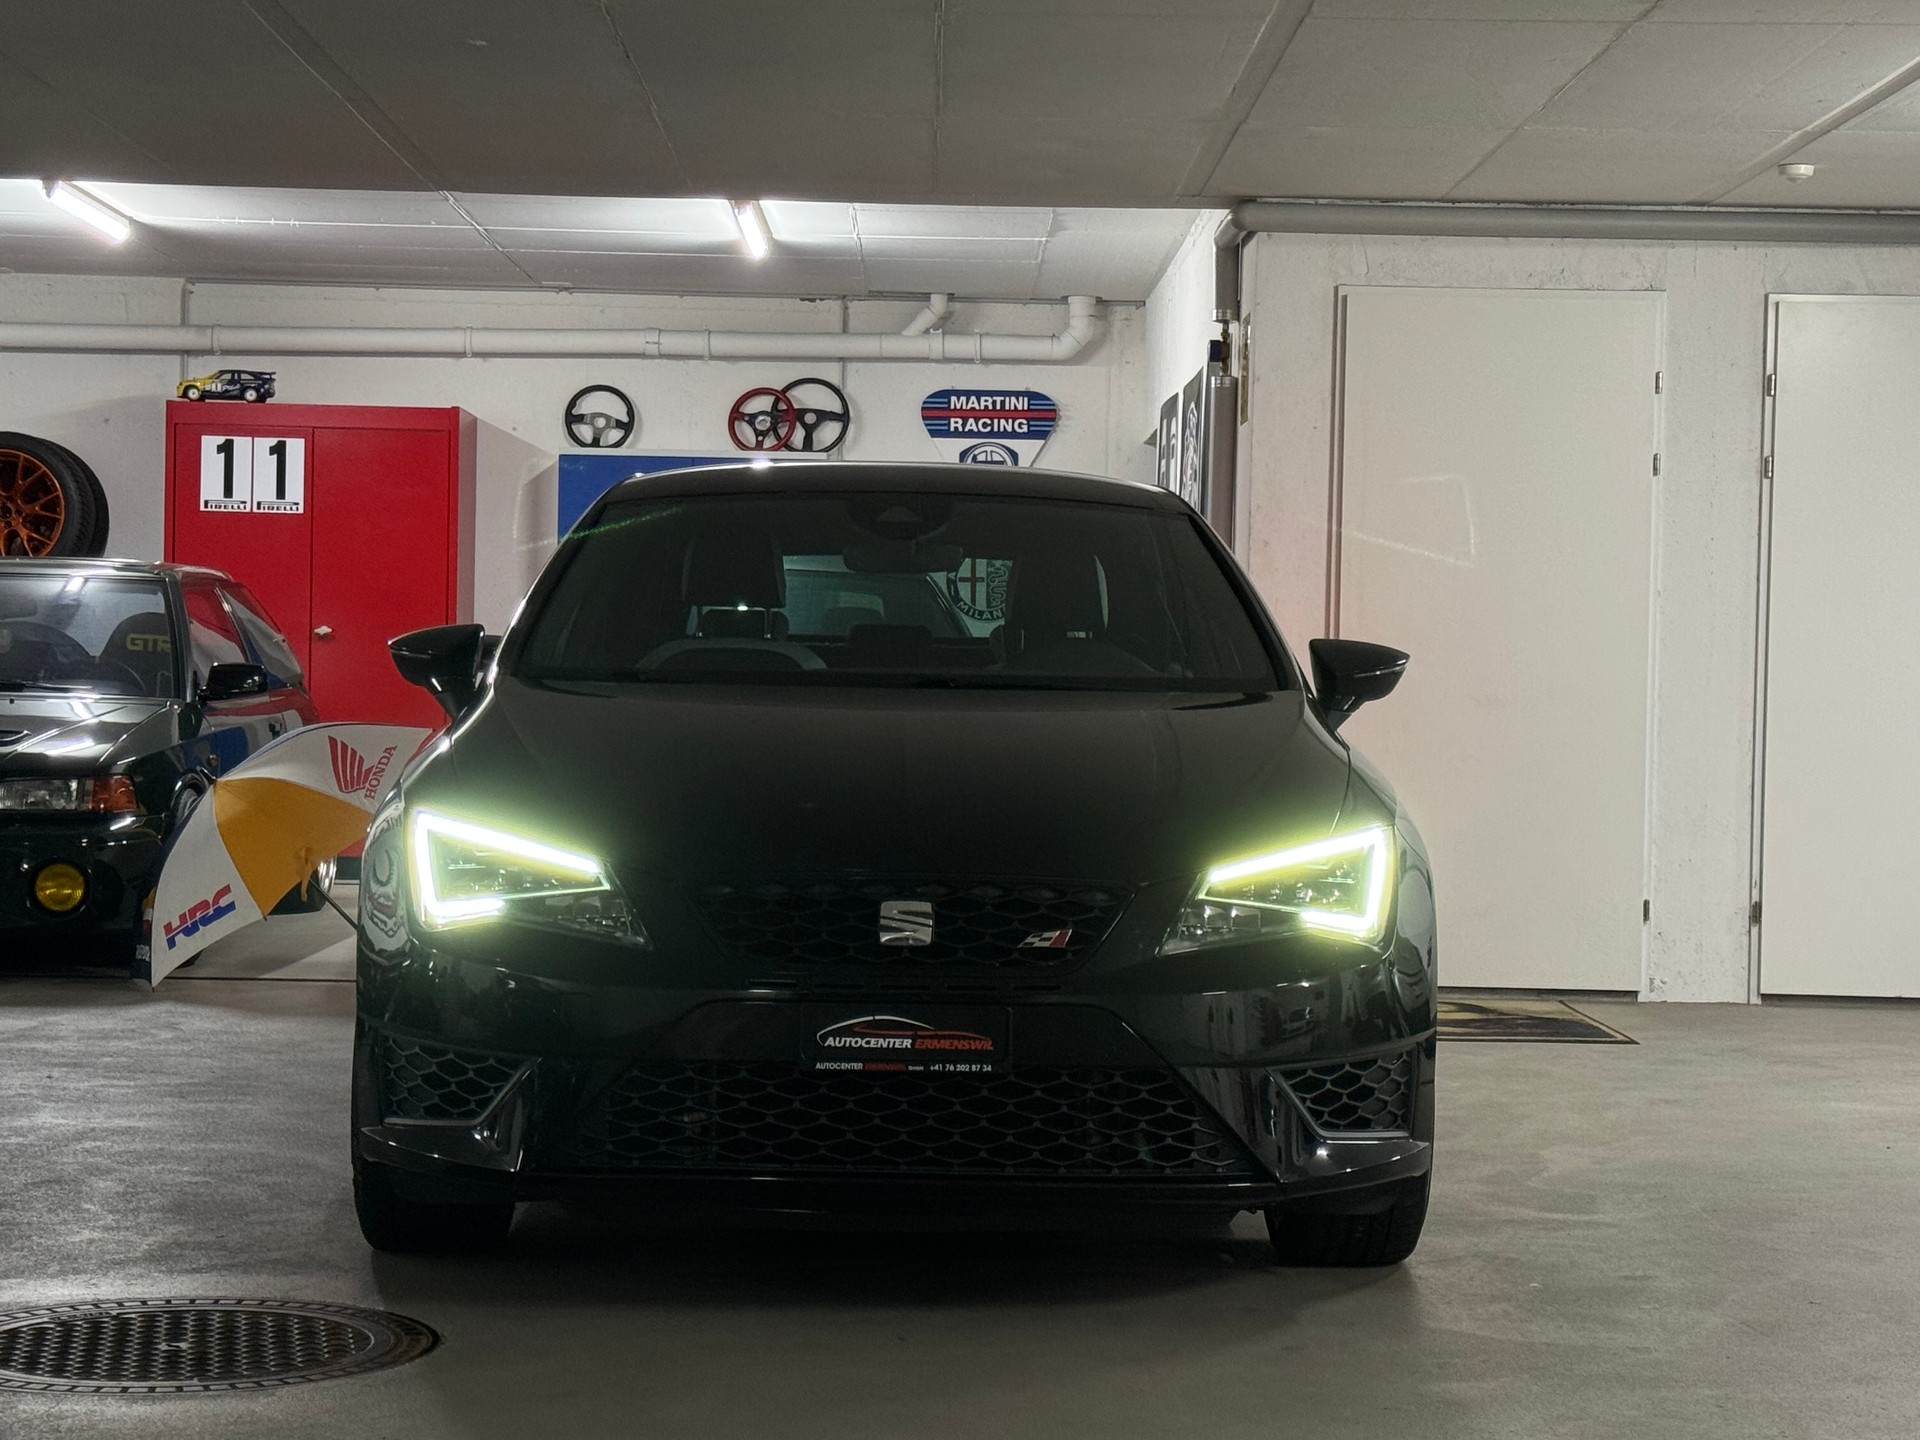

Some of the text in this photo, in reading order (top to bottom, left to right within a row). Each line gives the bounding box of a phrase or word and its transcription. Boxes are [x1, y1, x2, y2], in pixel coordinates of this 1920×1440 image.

[949, 396, 1029, 411] MARTINI
[949, 418, 1029, 433] RACING
[204, 499, 247, 511] PIRELLI
[256, 500, 300, 512] PIRELLI
[125, 633, 171, 652] GTR
[364, 744, 399, 800] HONDA
[162, 883, 236, 951] HRC
[824, 1036, 912, 1049] AUTOCENTER
[815, 1062, 864, 1071] AUTOCENTER
[929, 1063, 943, 1072] +41
[945, 1063, 955, 1072] 76
[955, 1063, 970, 1072] 202
[971, 1063, 981, 1072] 87
[982, 1063, 993, 1072] 34
